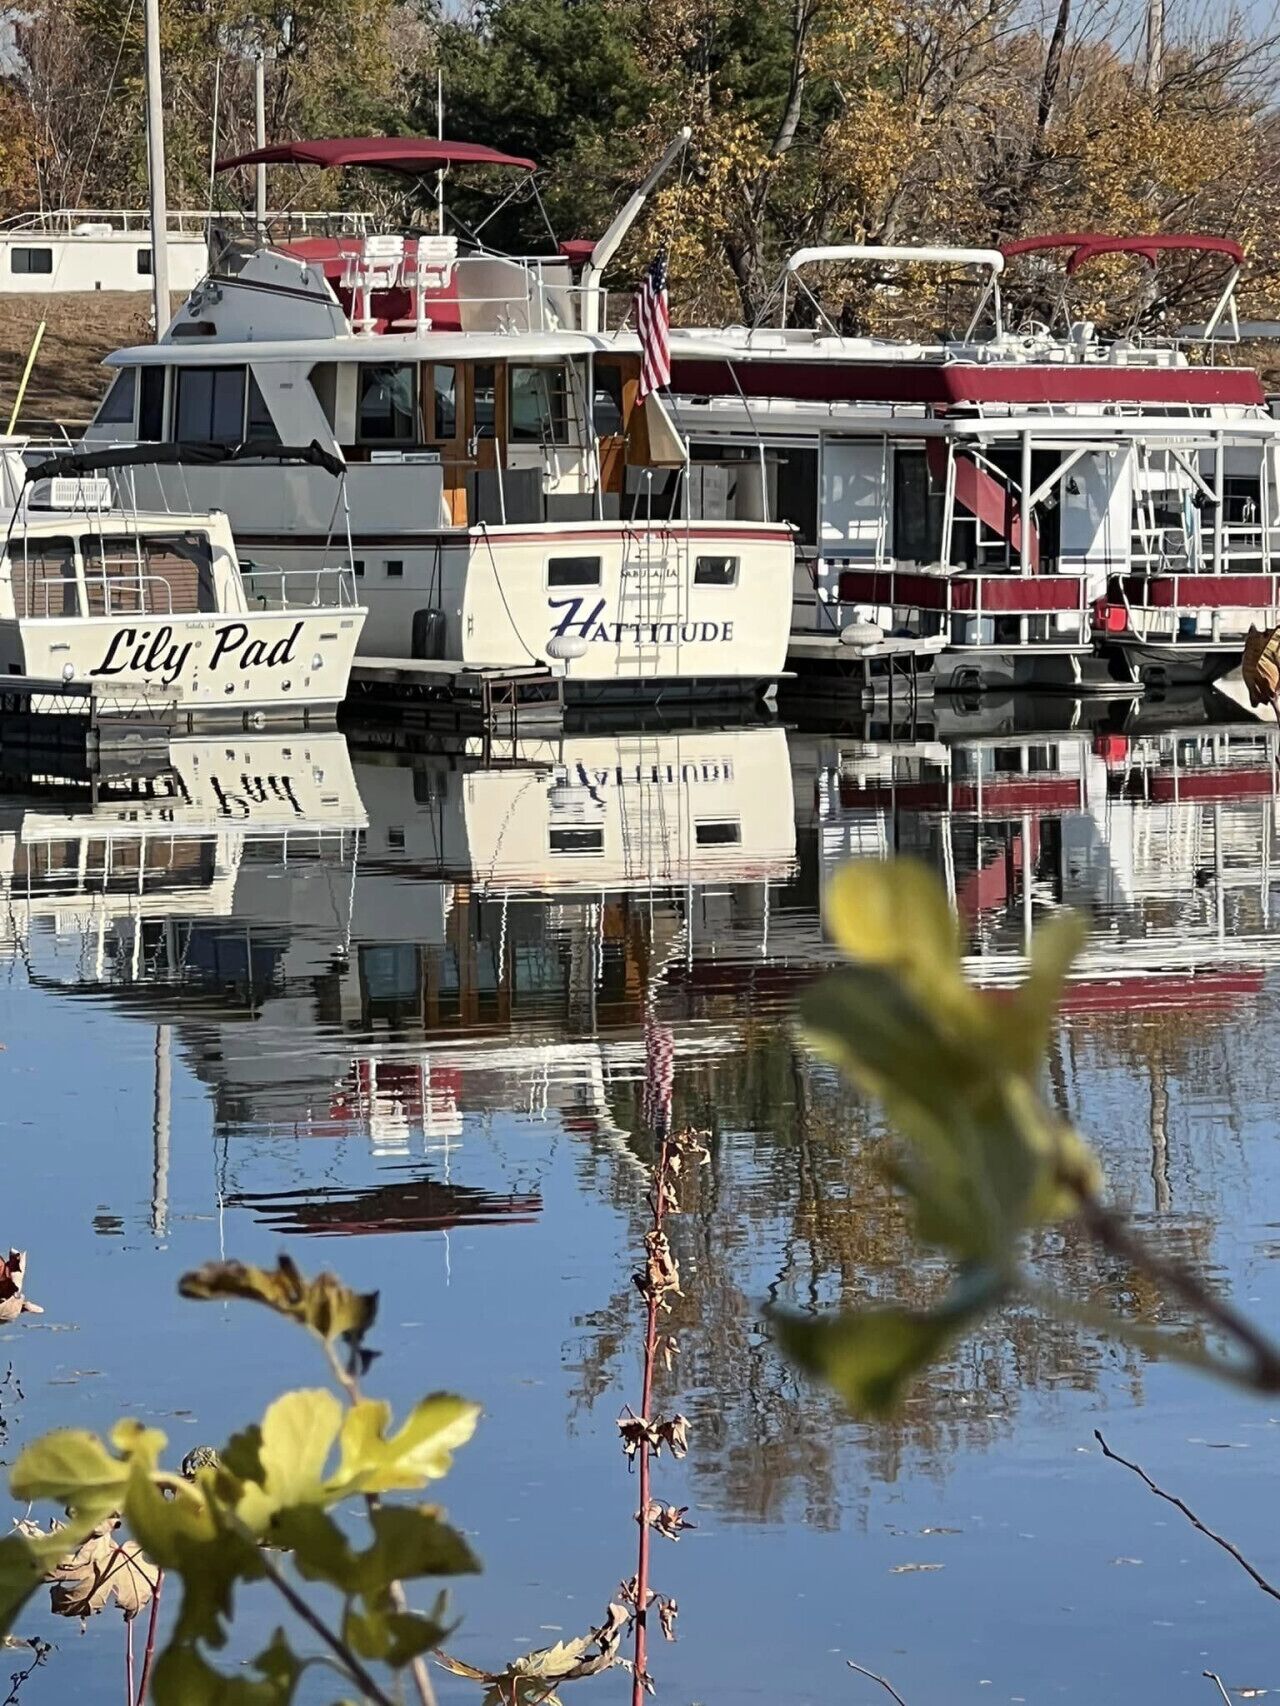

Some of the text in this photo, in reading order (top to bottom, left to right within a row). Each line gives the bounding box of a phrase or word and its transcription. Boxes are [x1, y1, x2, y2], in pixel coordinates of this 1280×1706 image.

[548, 597, 734, 642] HATTITUDE
[90, 621, 305, 684] Lily Pad
